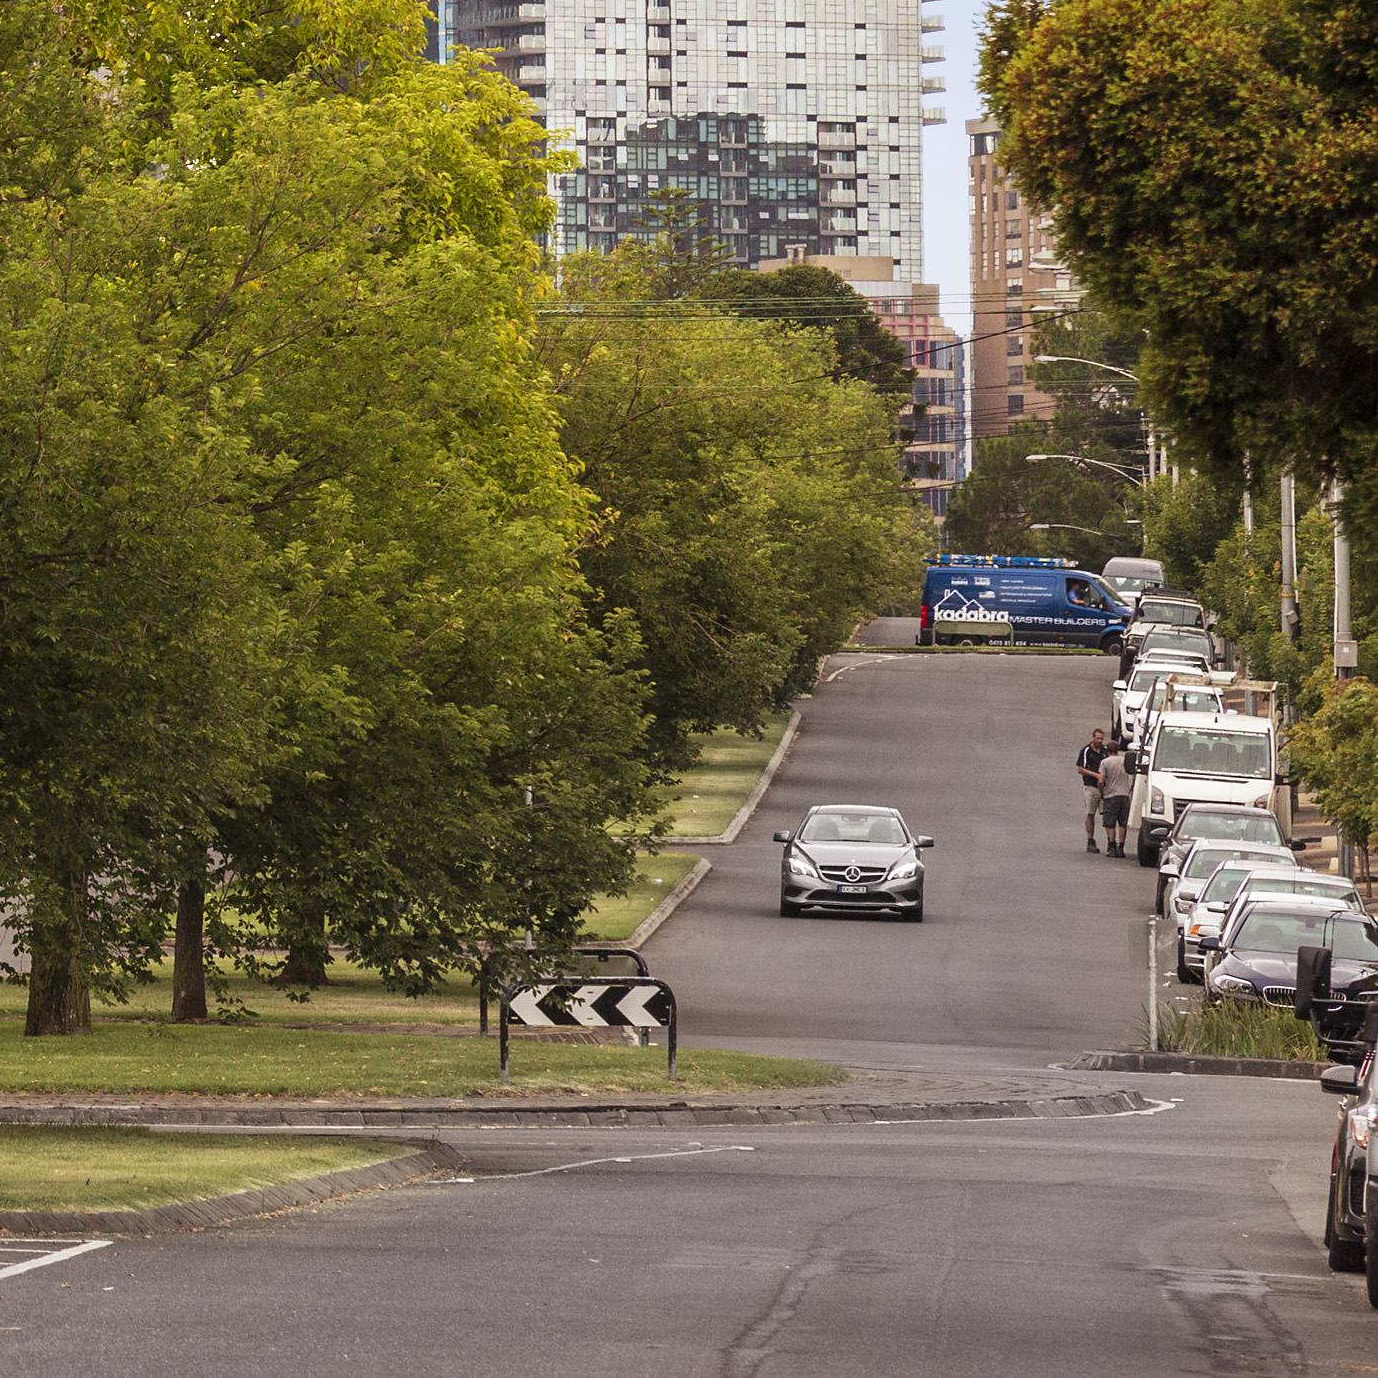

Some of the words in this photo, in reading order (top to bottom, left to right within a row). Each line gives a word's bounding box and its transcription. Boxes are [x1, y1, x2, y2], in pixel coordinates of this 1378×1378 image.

[934, 606, 1009, 622] kadabra
[1009, 616, 1053, 624] MASTER
[1054, 618, 1107, 626] BUILDERS
